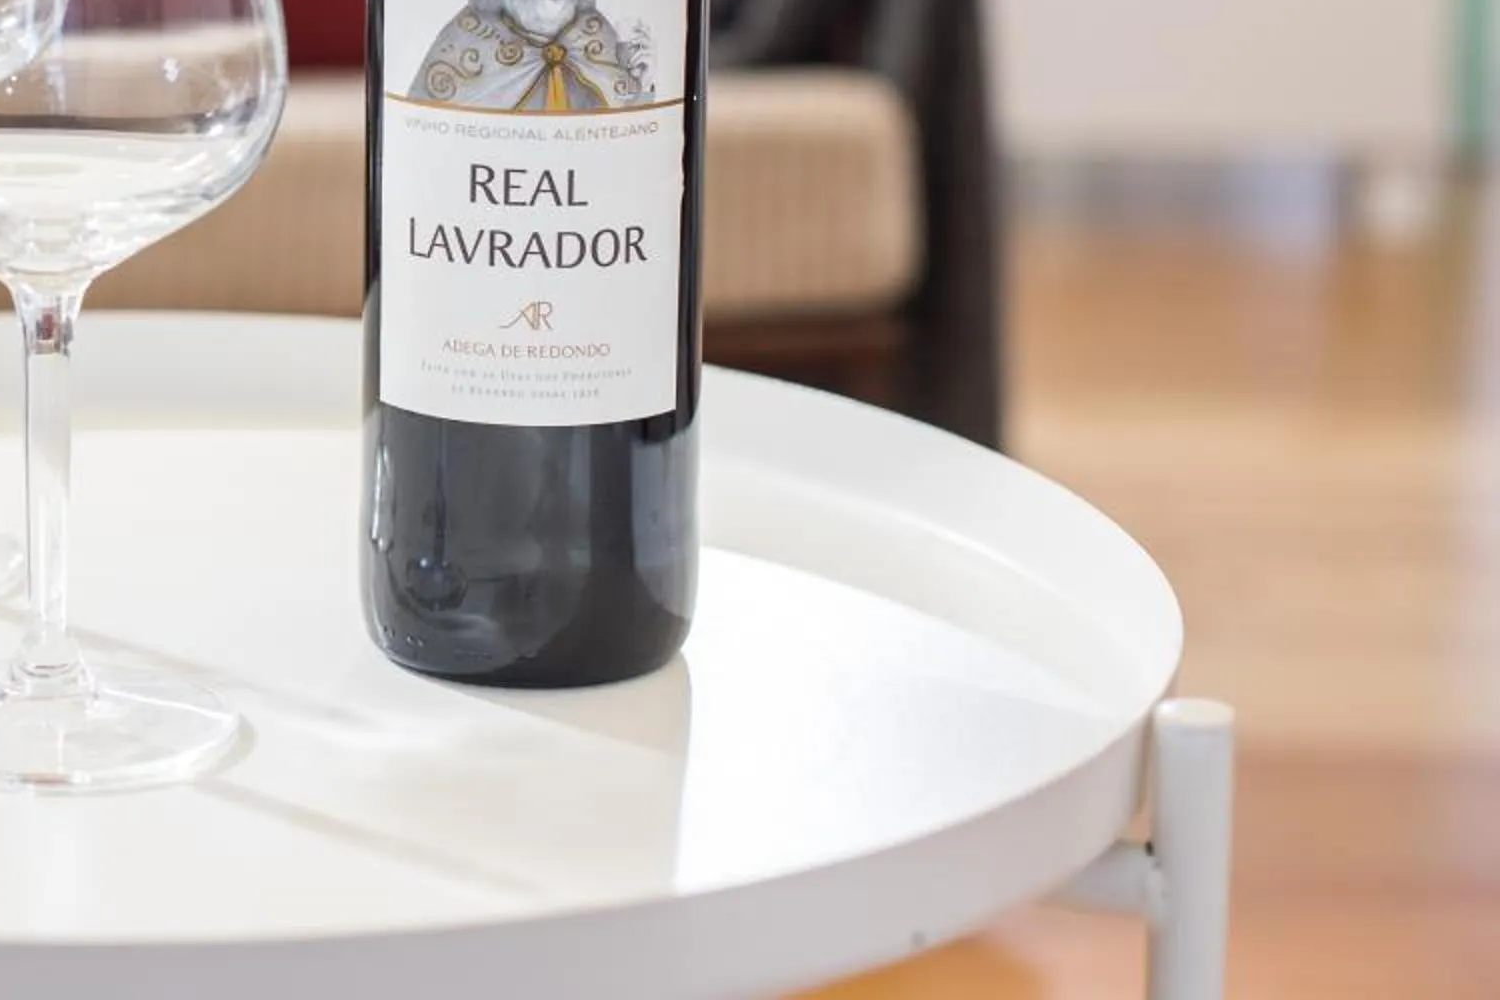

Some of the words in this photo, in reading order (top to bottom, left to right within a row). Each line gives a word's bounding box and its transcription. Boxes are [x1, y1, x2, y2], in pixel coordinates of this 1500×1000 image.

[454, 122, 547, 142] REGIONAL
[553, 121, 659, 141] ALENTEJANO
[469, 163, 589, 208] REAL
[408, 216, 648, 269] LAVRADOR
[441, 338, 497, 359] ADEGA
[501, 343, 524, 359] DE
[526, 343, 611, 359] REDONDO
